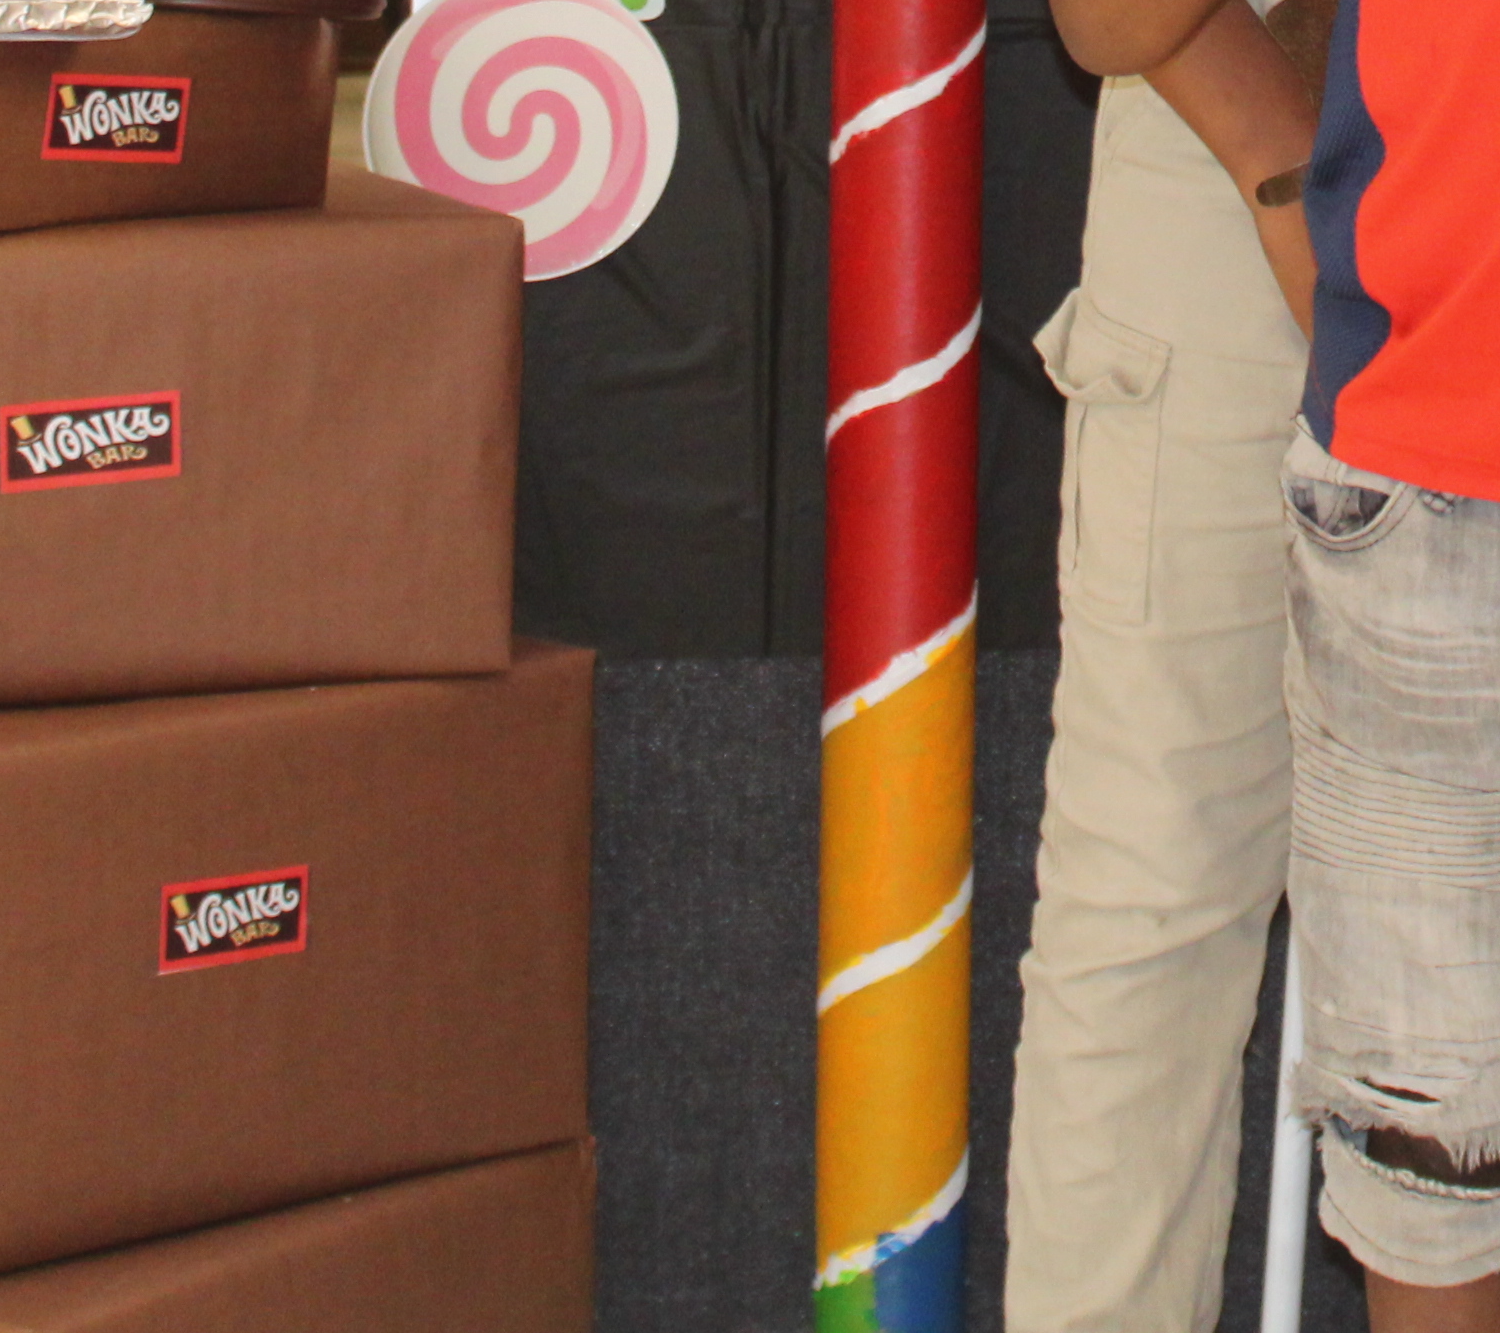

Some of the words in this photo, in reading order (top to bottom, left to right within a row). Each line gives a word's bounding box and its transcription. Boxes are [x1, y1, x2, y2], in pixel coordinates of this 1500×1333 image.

[59, 89, 180, 145] WONKA
[111, 126, 160, 148] BAR
[16, 406, 171, 475] WONKA
[85, 443, 149, 470] BAR
[174, 881, 300, 954] WONKA
[229, 920, 281, 947] BAR
